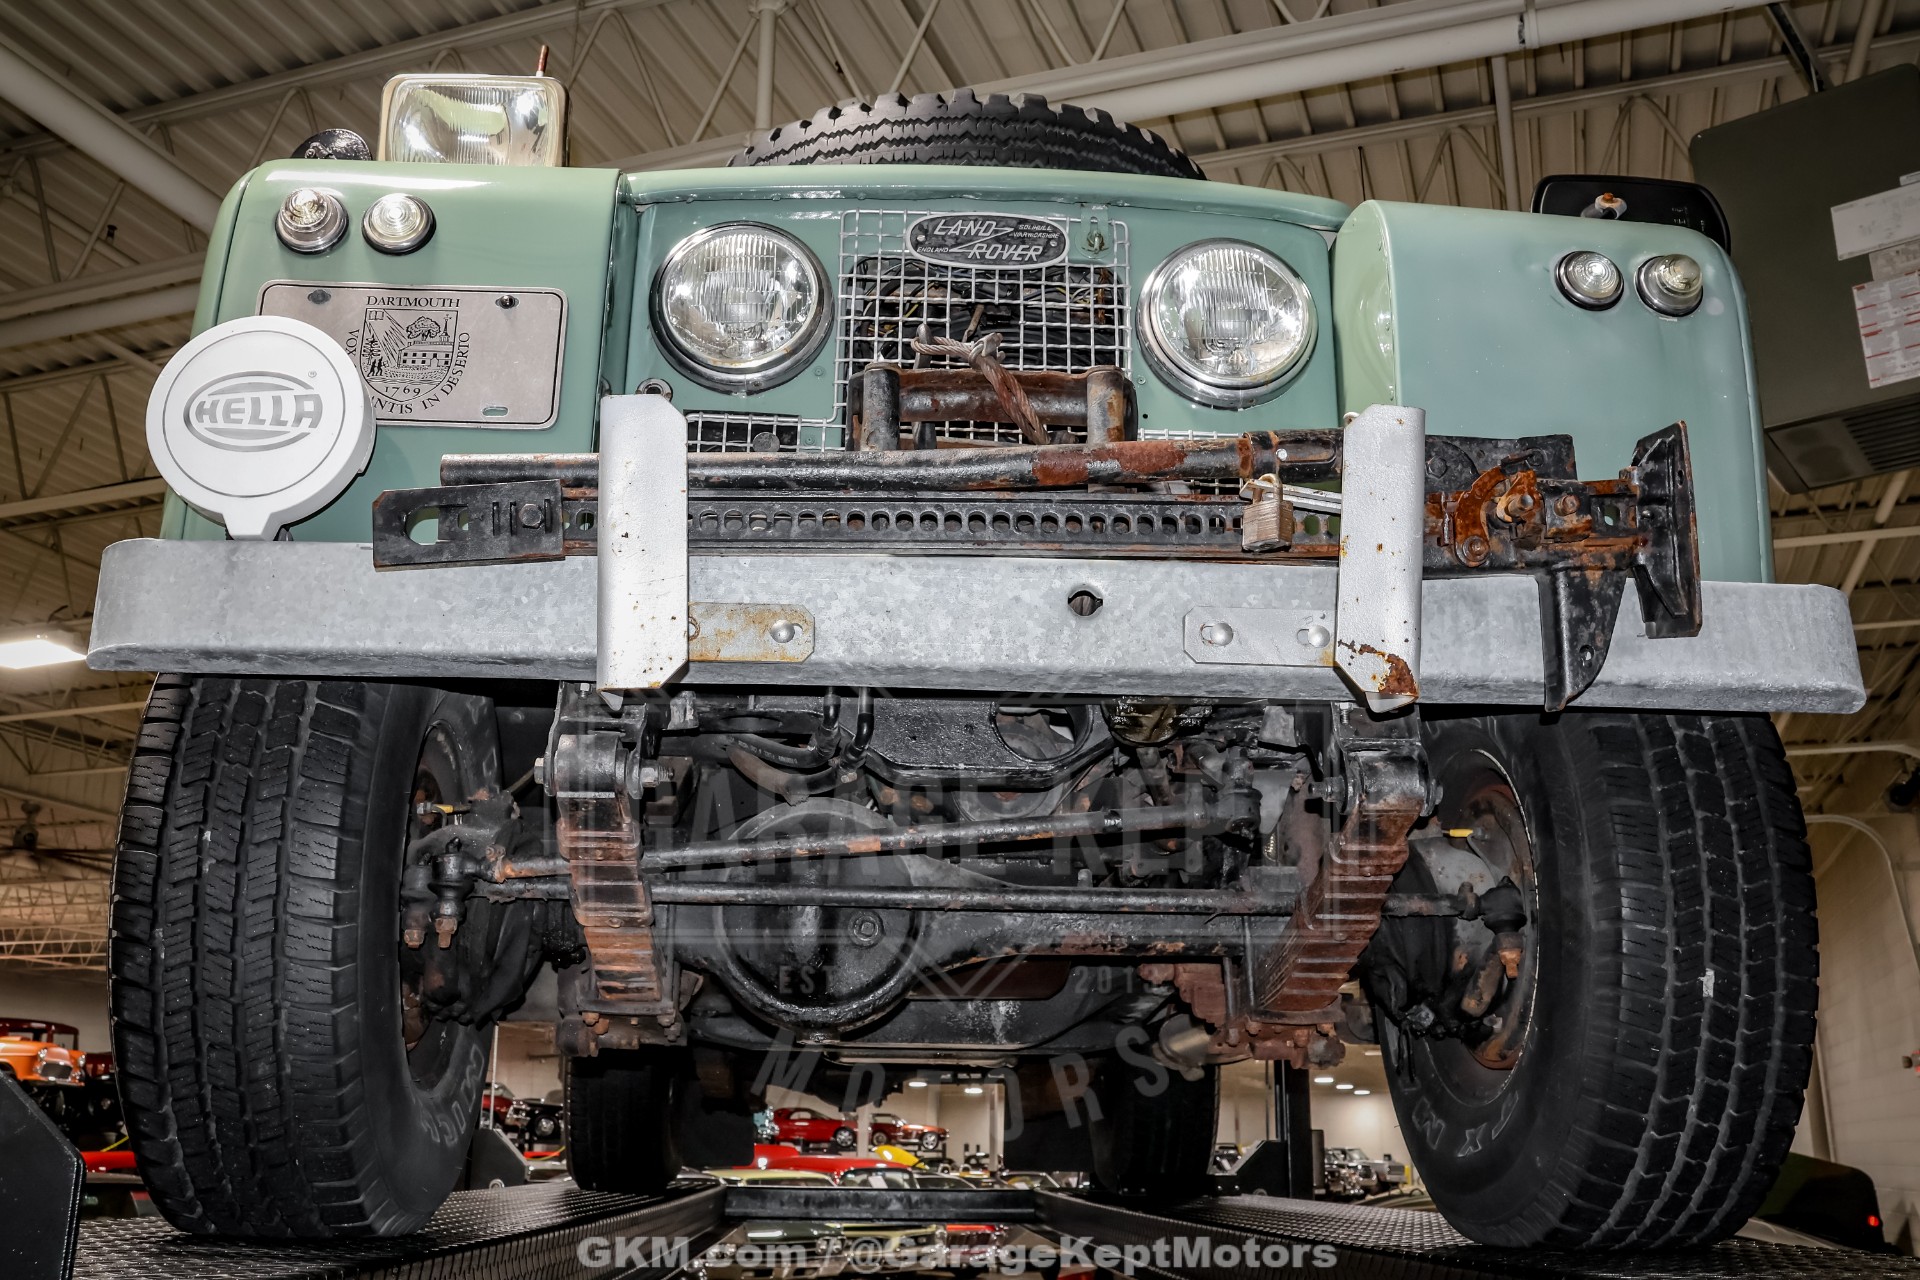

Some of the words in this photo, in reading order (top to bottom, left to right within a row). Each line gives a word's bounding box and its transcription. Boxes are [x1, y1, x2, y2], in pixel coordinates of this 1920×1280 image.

[934, 219, 997, 236] LAND
[967, 243, 1043, 261] ROVER
[366, 295, 460, 308] DARTMOUTH
[345, 328, 360, 357] VOX
[421, 393, 441, 410] IN
[440, 332, 471, 396] DESERTO
[385, 386, 421, 398] 1769
[194, 393, 323, 429] HELLA
